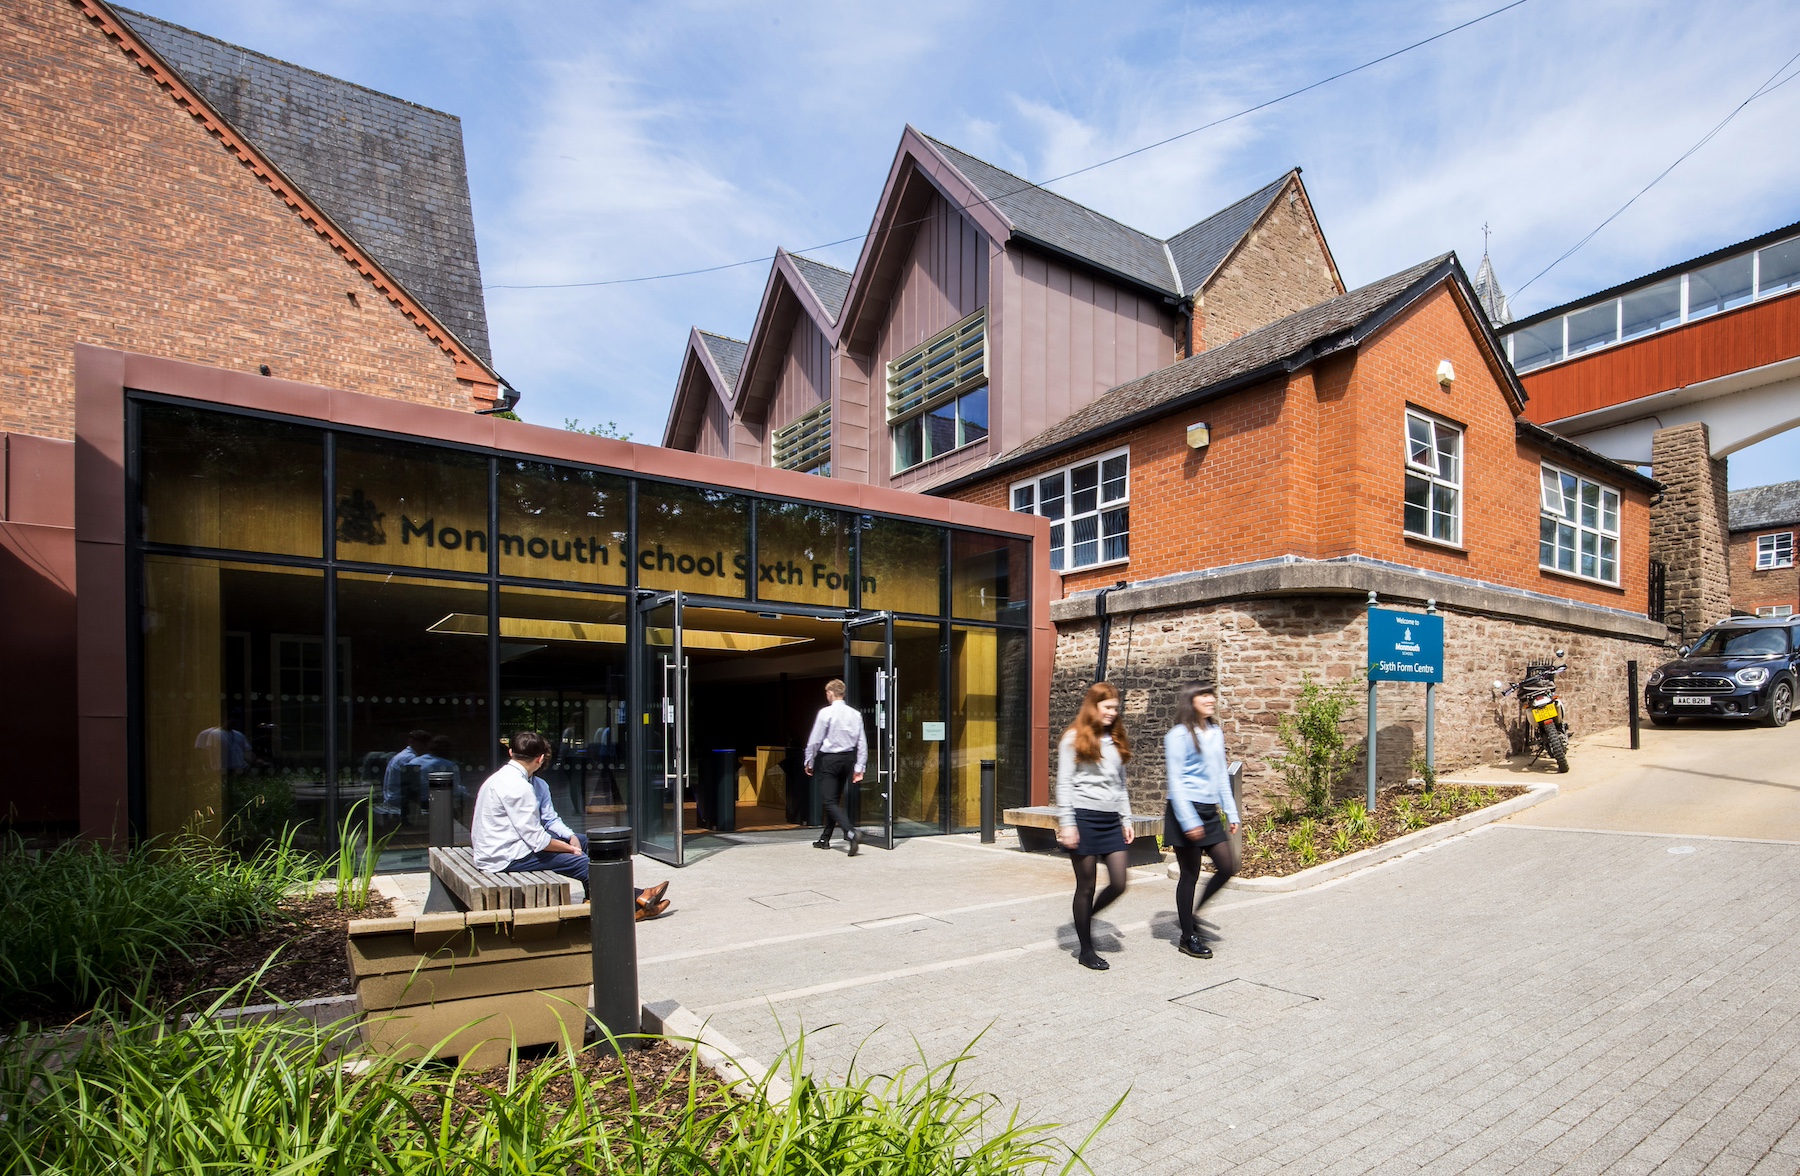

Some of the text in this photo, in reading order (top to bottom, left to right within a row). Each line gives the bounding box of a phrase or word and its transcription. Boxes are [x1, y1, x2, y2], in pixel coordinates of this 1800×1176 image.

[402, 514, 609, 566] Monmouth
[733, 554, 803, 586] Sxth
[1396, 617, 1414, 625] Welcome
[1395, 643, 1420, 652] Monmouth
[1380, 661, 1434, 674] Sixth Form Centre
